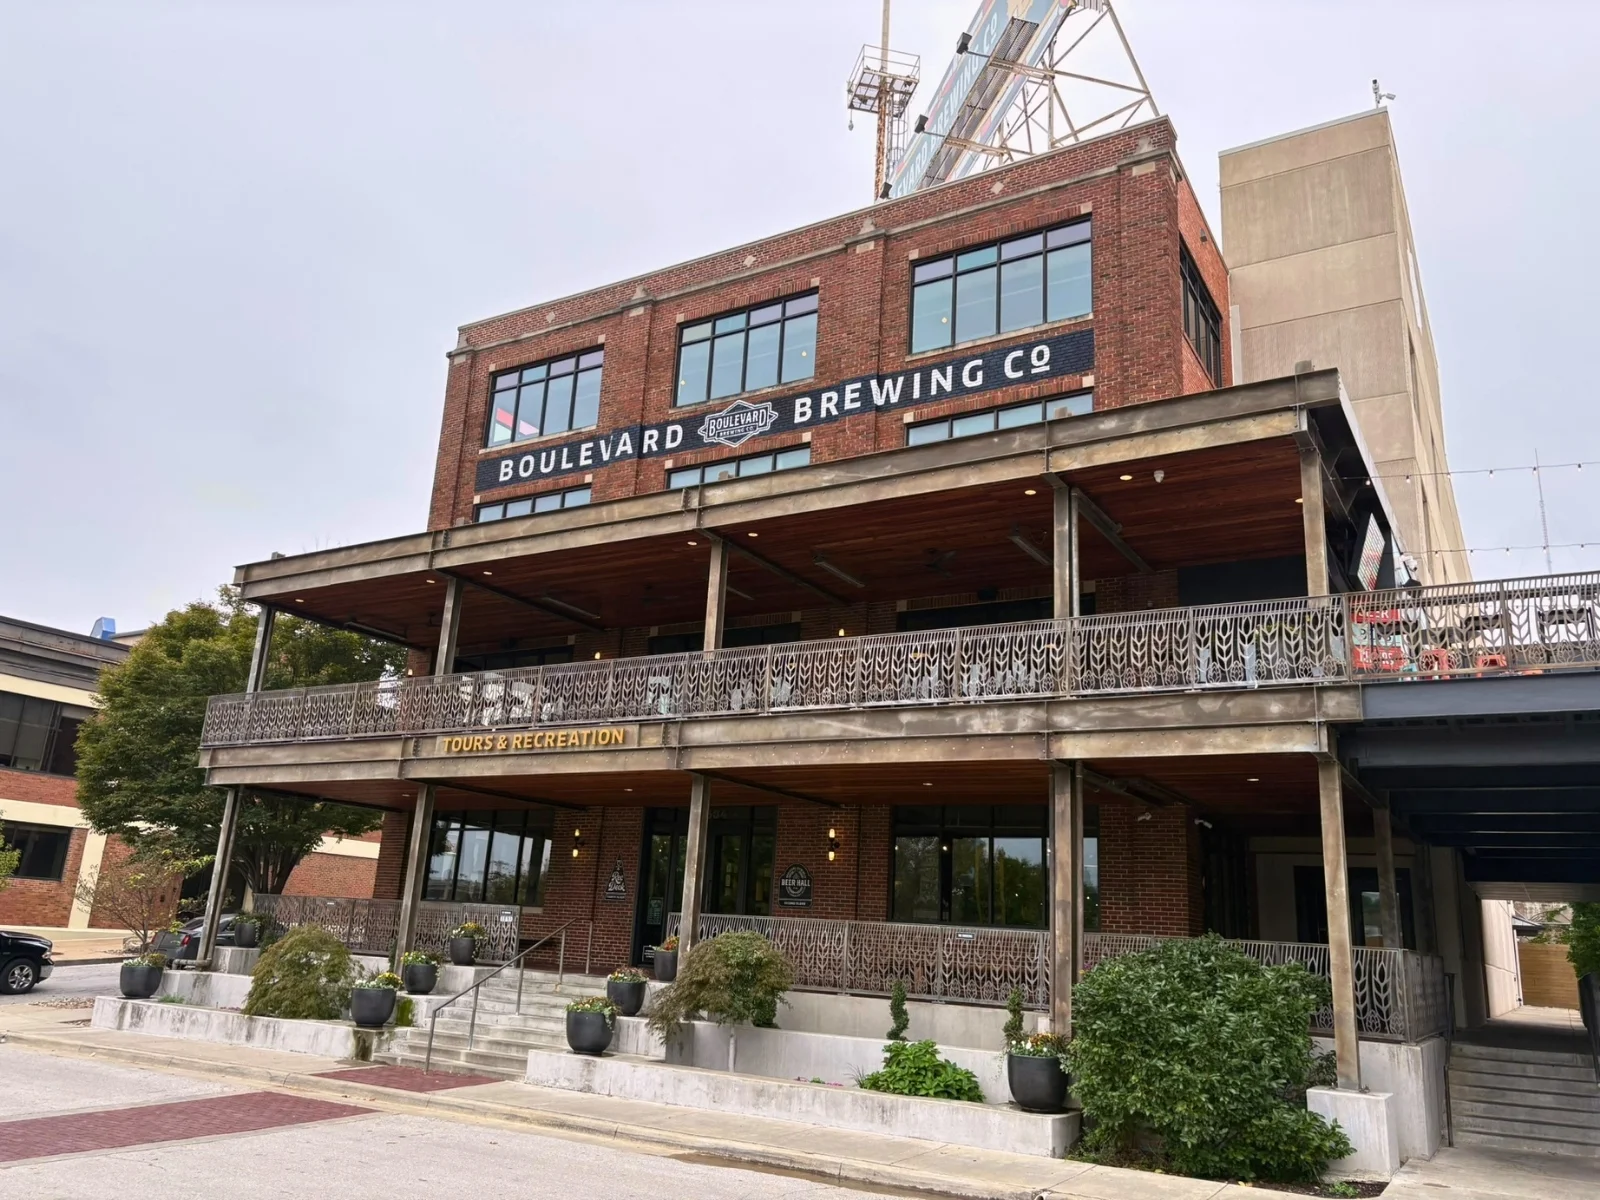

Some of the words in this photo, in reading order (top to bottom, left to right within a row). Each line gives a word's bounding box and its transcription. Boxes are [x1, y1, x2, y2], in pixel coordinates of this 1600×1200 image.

[499, 424, 684, 482] BOULEVARD
[793, 359, 984, 424] BREWING
[709, 409, 767, 437] BOULEVARD
[443, 735, 493, 752] TOURS
[497, 734, 507, 749] &
[511, 728, 625, 749] RECREATION
[781, 878, 796, 887] BEER
[796, 879, 811, 887] HALL
